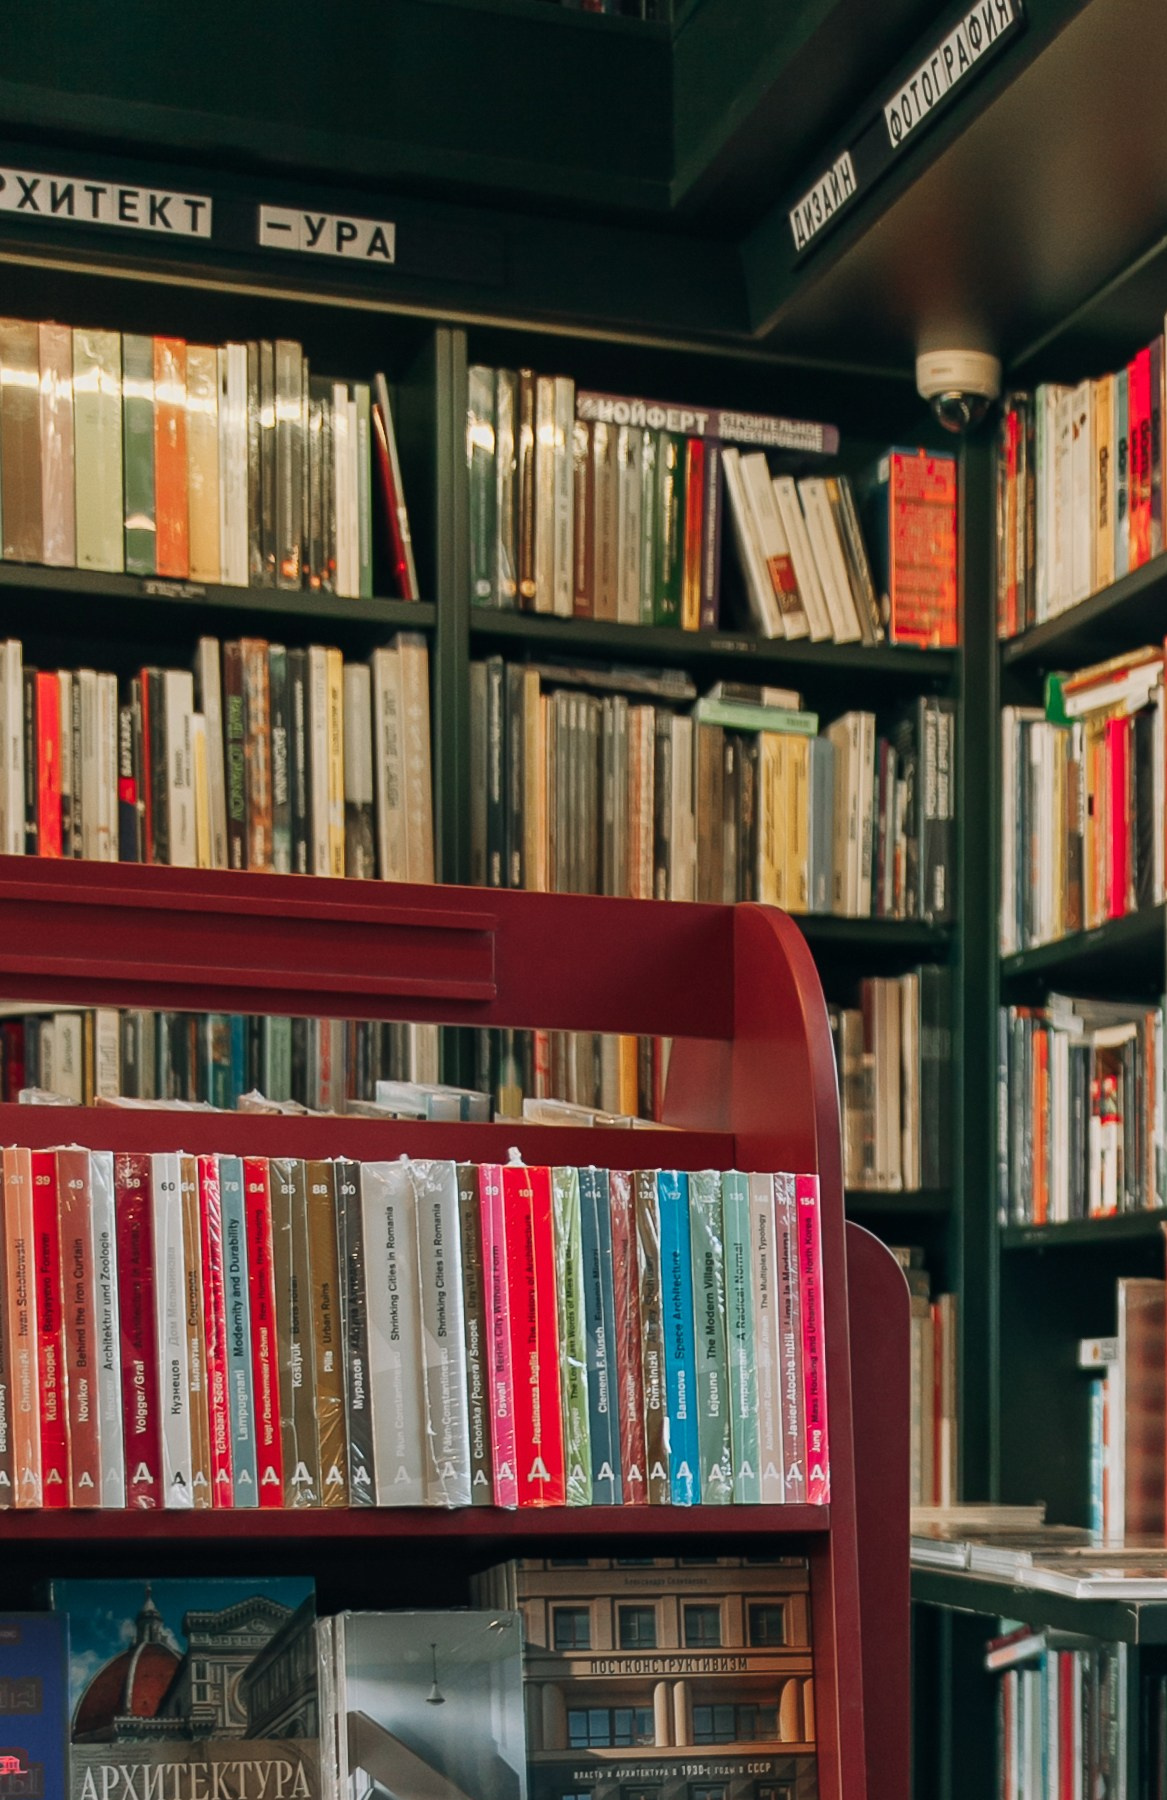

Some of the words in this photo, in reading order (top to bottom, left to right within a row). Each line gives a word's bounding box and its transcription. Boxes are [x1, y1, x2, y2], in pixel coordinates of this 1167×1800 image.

[161, 1181, 175, 1191] 60
[386, 1207, 395, 1248] Romania
[433, 1204, 442, 1245] Romania
[75, 1239, 83, 1278] Curtain
[100, 1232, 110, 1280] Zoologie
[229, 1219, 240, 1272] Durability
[388, 1252, 396, 1261] in
[435, 1249, 443, 1257] in
[735, 1243, 744, 1283] Normal
[232, 1277, 240, 1297] and
[389, 1264, 397, 1291] Cities
[436, 1261, 445, 1288] Cities
[673, 1251, 681, 1319] Architecture
[705, 1252, 714, 1289] Village
[75, 1283, 84, 1303] Iron
[102, 1285, 111, 1305] und
[736, 1287, 746, 1328] Radical
[75, 1307, 85, 1326] the
[233, 1301, 243, 1356] Modernity
[322, 1314, 332, 1343] Urban
[389, 1295, 400, 1340] Shrinking
[437, 1291, 448, 1337] Shrinking
[706, 1293, 715, 1335] Modern
[77, 1329, 86, 1367] Behind
[103, 1309, 113, 1370] Architektur
[469, 1319, 479, 1356] Snopek
[596, 1327, 605, 1357] Kusch
[675, 1323, 684, 1359] Space
[707, 1340, 716, 1359] The
[45, 1345, 56, 1388] Snopek
[192, 1339, 200, 1391] Милютин
[292, 1343, 303, 1387] Kostyuk
[354, 1359, 365, 1409] Мурадов
[47, 1392, 57, 1420] Kuba
[79, 1379, 88, 1421] Novikov
[172, 1360, 182, 1414] Кузнецов
[236, 1370, 248, 1440] Lampugnani
[498, 1382, 507, 1417] Oswalt
[678, 1370, 687, 1419] Bannova
[709, 1372, 720, 1417] Lejeune
[813, 1430, 822, 1452] Jung
[591, 1658, 748, 1674] ПОСТКОНСТРУКТИВИЗМ
[748, 1762, 771, 1773] СССР
